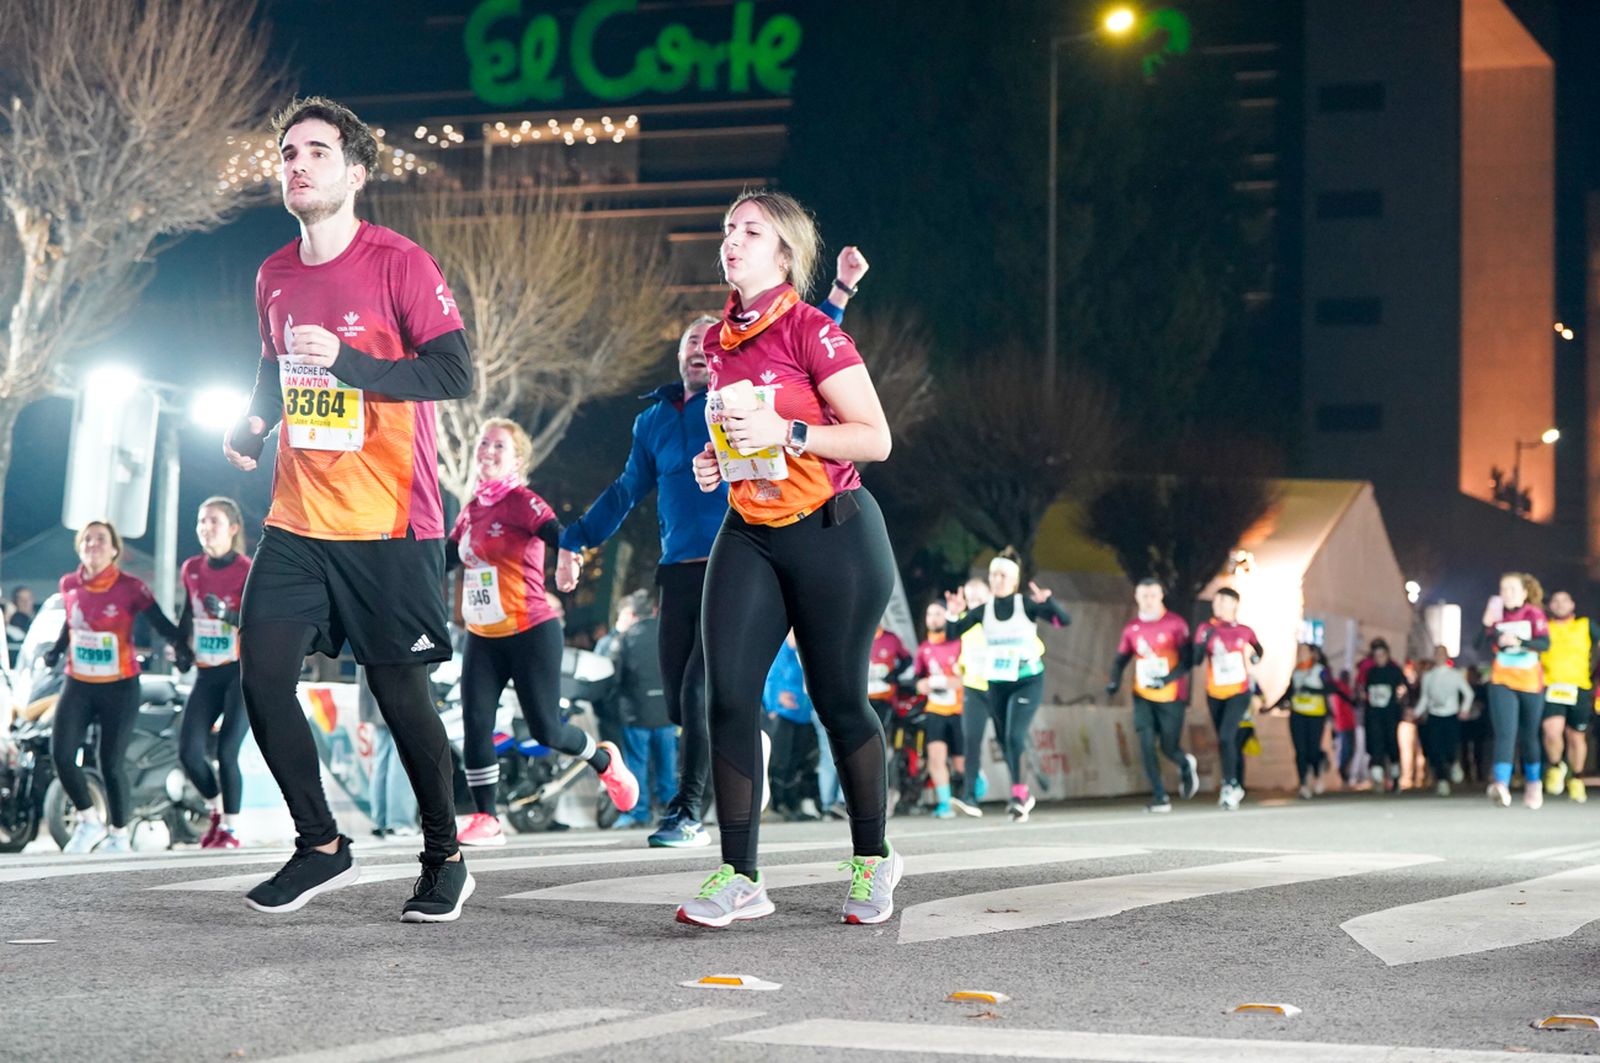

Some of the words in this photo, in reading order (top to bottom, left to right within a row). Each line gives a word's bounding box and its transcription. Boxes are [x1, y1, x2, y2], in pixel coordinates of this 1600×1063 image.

[464, 0, 564, 104] El
[570, 0, 802, 100] Corte
[292, 366, 317, 376] NOCHE
[286, 388, 346, 418] 3364
